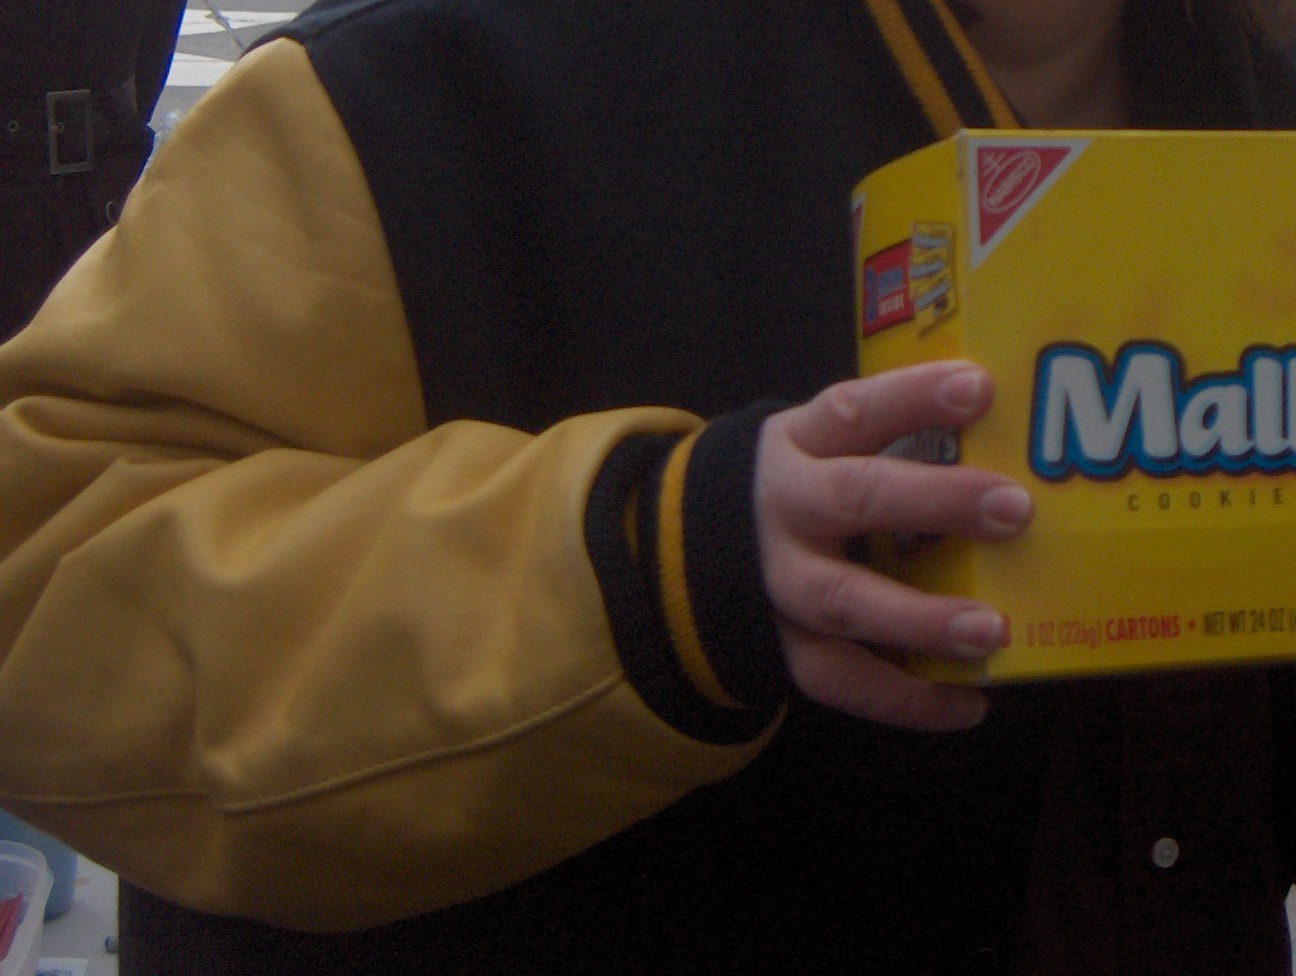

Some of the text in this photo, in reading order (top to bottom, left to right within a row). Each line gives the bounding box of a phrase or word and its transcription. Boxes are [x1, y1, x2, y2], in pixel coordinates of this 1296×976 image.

[1105, 614, 1182, 642] CARTONS
[1204, 612, 1225, 636] NET
[1229, 609, 1247, 634] WT
[1250, 608, 1266, 632] 24
[1269, 607, 1287, 631] OZ
